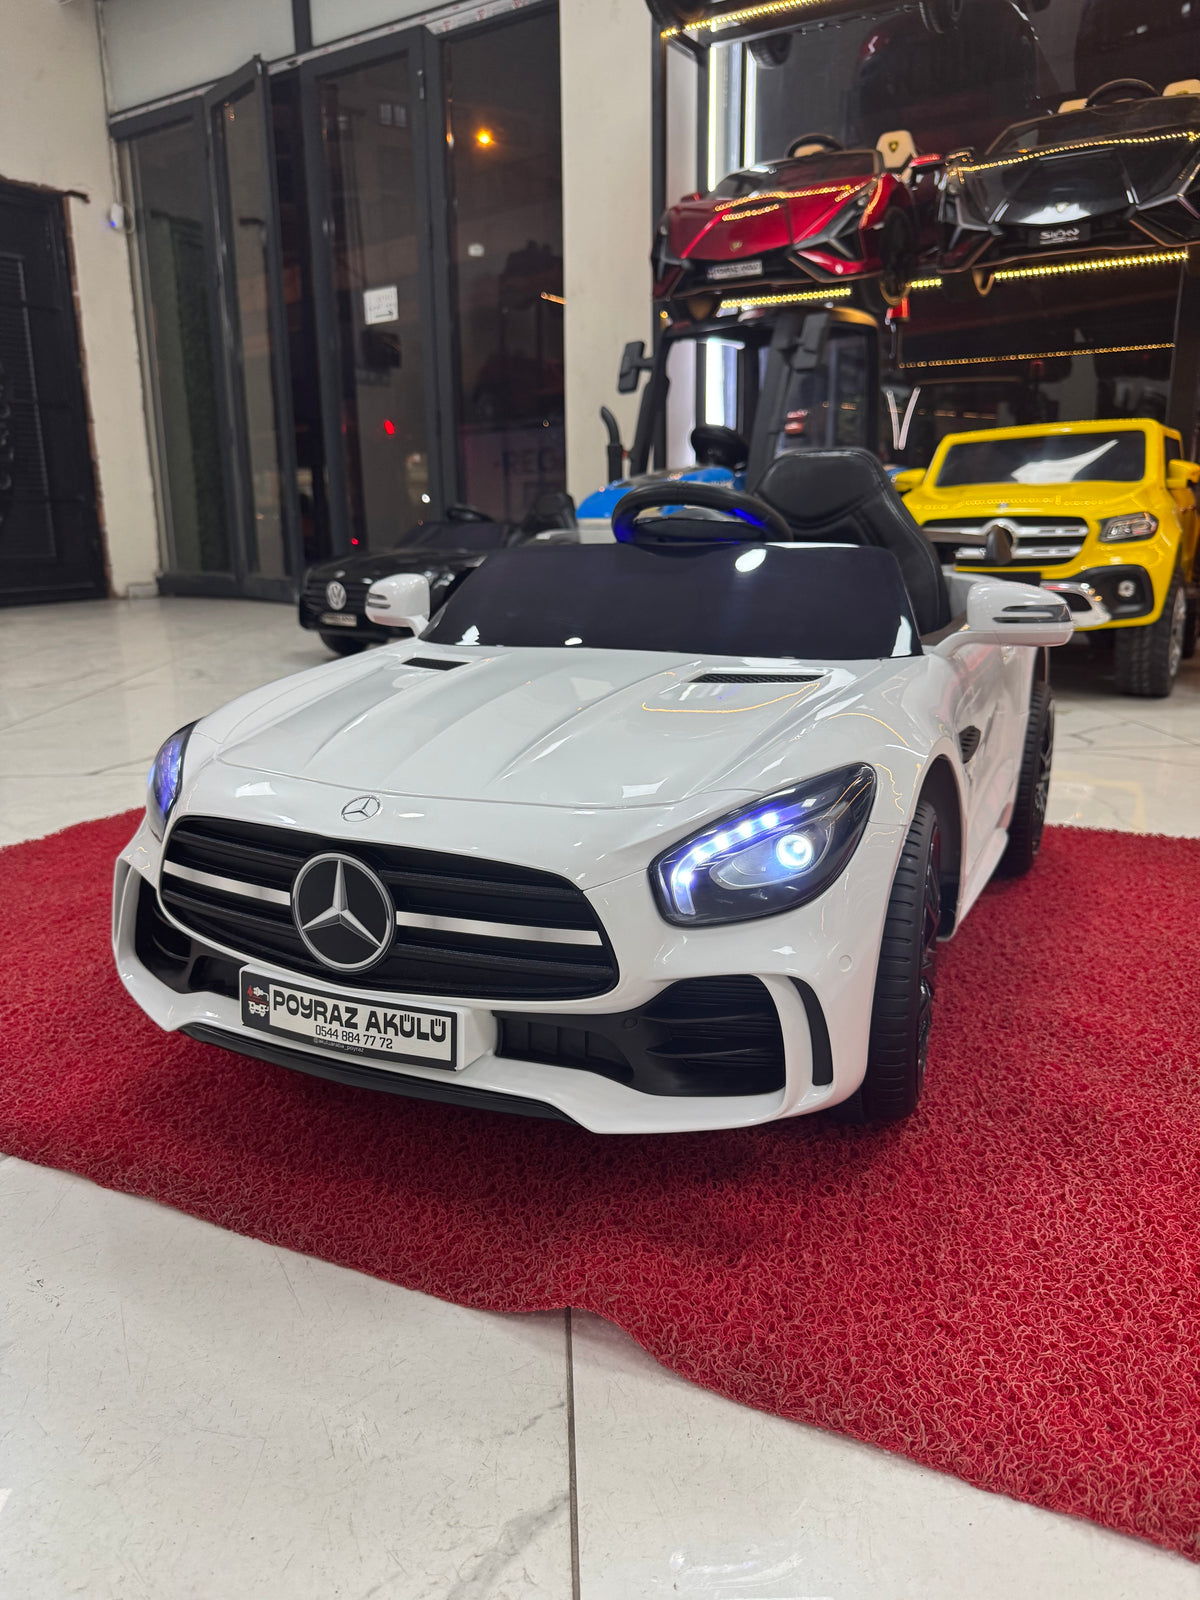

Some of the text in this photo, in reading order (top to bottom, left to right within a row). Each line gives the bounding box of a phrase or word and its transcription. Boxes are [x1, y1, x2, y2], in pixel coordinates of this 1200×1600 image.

[273, 989, 447, 1043] POYRAZ AKÜLÜ
[315, 1024, 393, 1050] 0544 884 77 72
